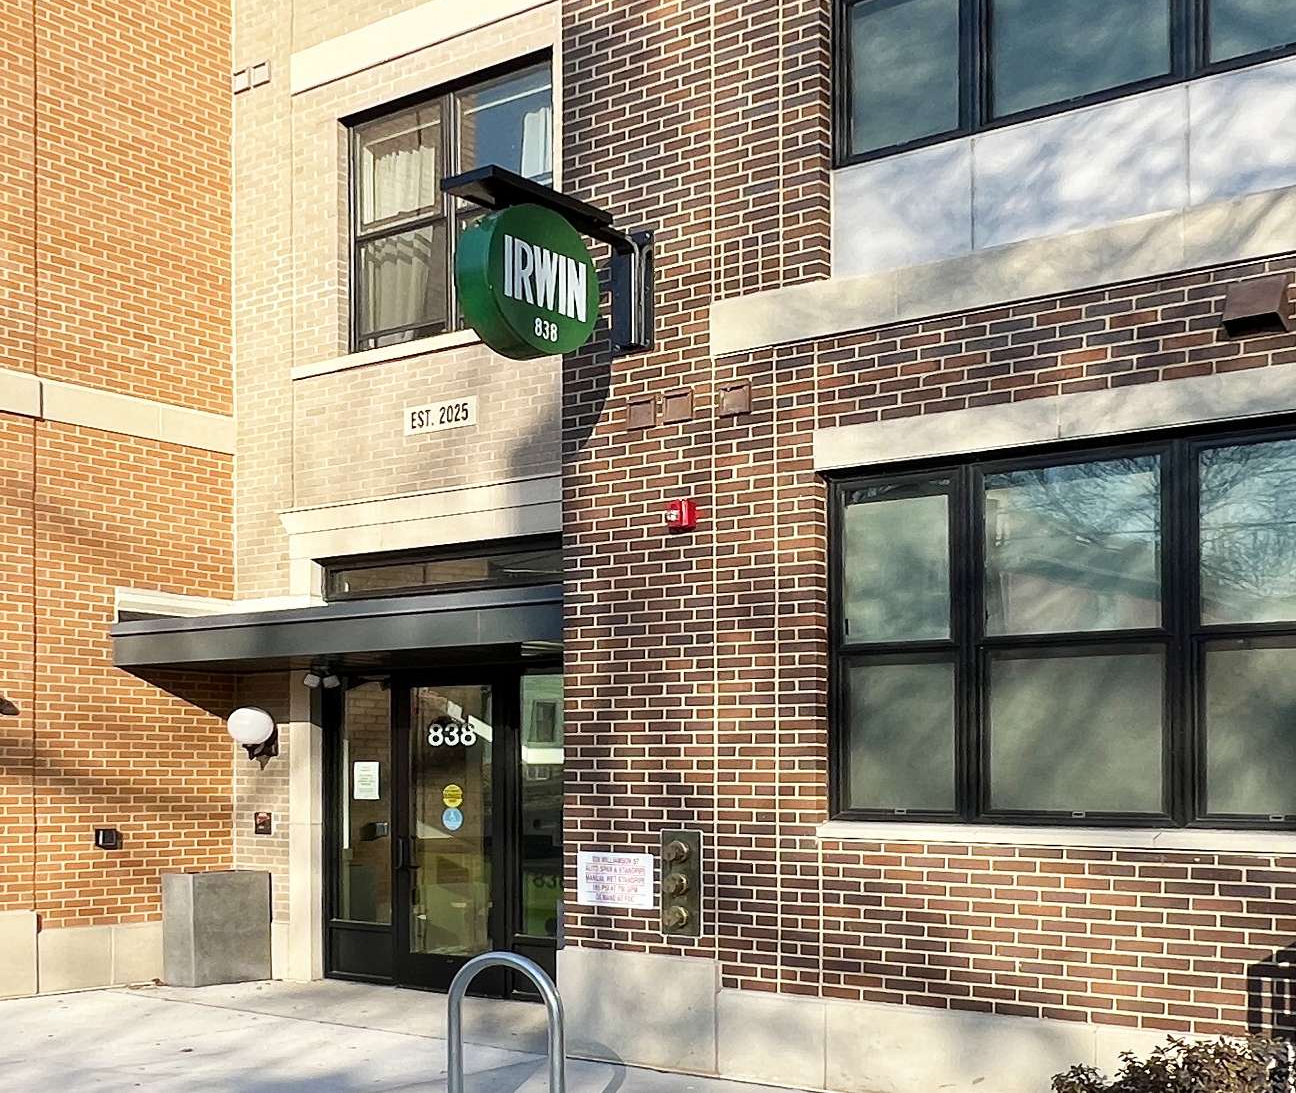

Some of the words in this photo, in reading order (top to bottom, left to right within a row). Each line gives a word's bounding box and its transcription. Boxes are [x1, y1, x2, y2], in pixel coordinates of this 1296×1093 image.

[504, 234, 587, 323] IRWIN
[535, 317, 558, 343] 838
[411, 409, 434, 429] EST.
[439, 402, 469, 425] 2025
[428, 723, 477, 747] 838
